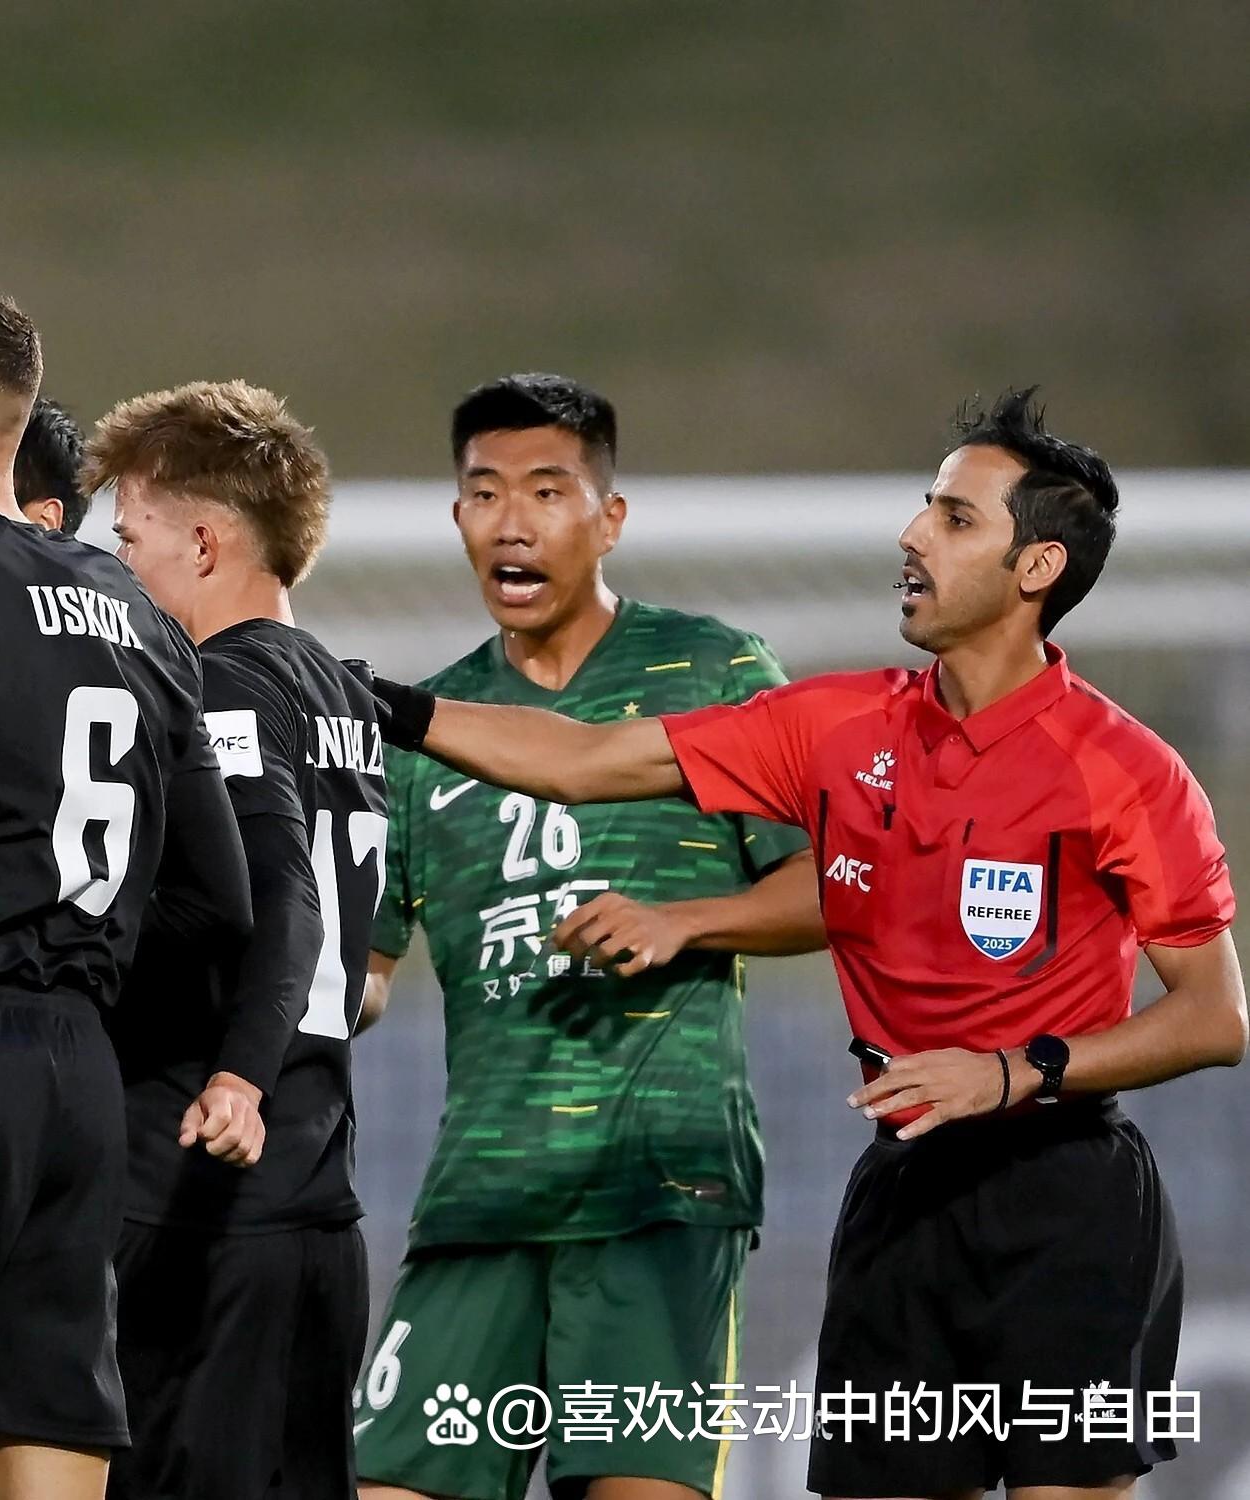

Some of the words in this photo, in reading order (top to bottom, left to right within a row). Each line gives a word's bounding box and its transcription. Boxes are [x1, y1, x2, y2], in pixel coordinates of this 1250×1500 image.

[213, 736, 250, 751] AFC
[52, 686, 139, 916] 6
[499, 792, 581, 882] 26
[826, 854, 873, 893] AFC
[969, 867, 1033, 893] FIFA
[967, 905, 1032, 921] REFEREE
[982, 937, 1012, 950] 2025
